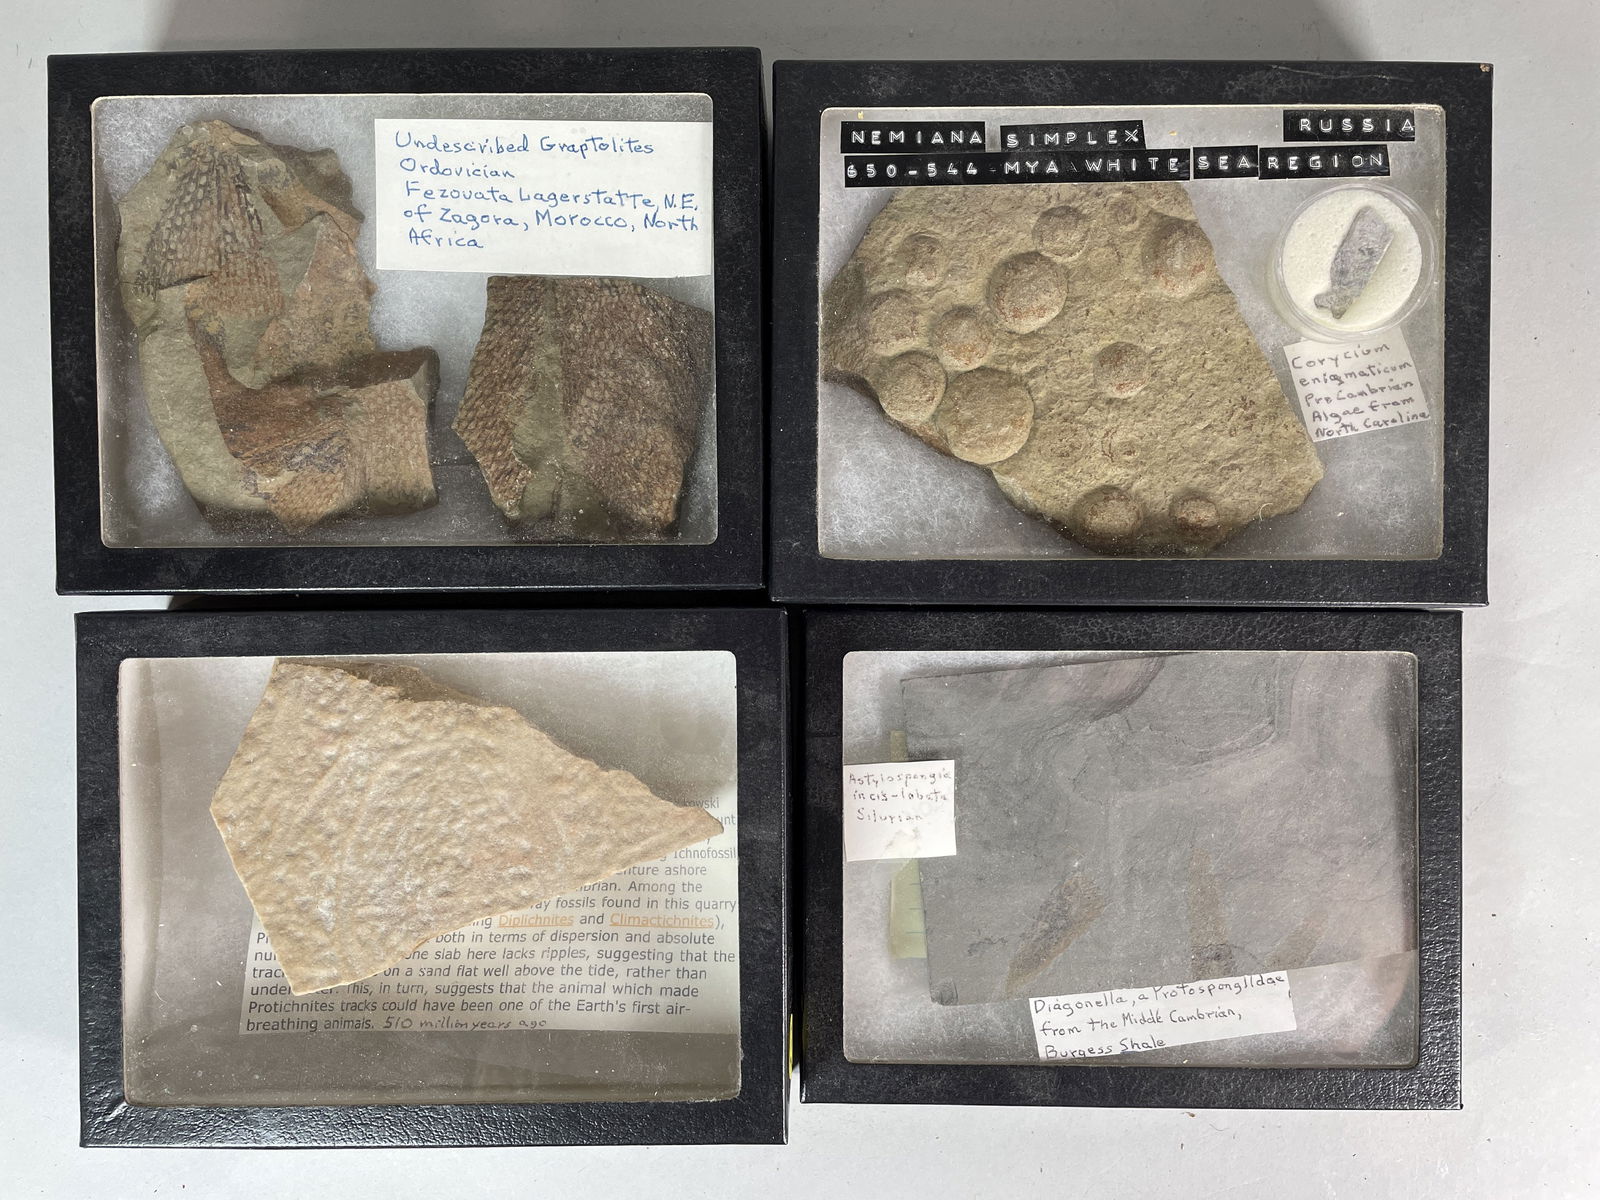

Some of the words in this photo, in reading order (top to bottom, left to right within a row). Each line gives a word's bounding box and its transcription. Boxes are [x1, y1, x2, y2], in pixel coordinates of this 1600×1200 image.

[1299, 118, 1414, 133] RUSSIA
[395, 131, 529, 153] Undescribed
[540, 135, 655, 159] Graptolites
[851, 130, 983, 146] NEMIANA
[1006, 129, 1139, 148] SIMPLEX
[400, 158, 515, 179] Ordovician
[1004, 160, 1059, 175] MYA
[1085, 157, 1180, 173] WHITE
[1197, 156, 1251, 170] SEA
[1267, 154, 1384, 171] REGION
[403, 204, 432, 223] of
[439, 207, 529, 231] Zagora,
[536, 210, 635, 232] Morocco,
[644, 213, 699, 231] North
[409, 228, 484, 249] Africa
[1312, 407, 1364, 424] Algae
[1368, 397, 1415, 412] from
[1315, 422, 1359, 438] North
[857, 807, 923, 824] Silurian
[665, 865, 707, 875] ashore
[628, 881, 676, 895] Among
[682, 881, 703, 892] the
[556, 897, 596, 909] fossils
[602, 897, 640, 909] found
[647, 897, 659, 909] in
[665, 897, 689, 910] this
[695, 899, 736, 912] quarry
[499, 914, 574, 928] Diplichnites
[580, 913, 604, 925] and
[471, 931, 483, 943] in
[489, 932, 526, 943] terms
[532, 930, 546, 943] of
[550, 930, 619, 946] dispersion
[626, 932, 650, 943] and
[656, 933, 715, 944] absolute
[434, 948, 461, 960] slab
[467, 948, 496, 960] here
[502, 947, 535, 960] lacks
[541, 946, 590, 962] ripples,
[597, 948, 673, 963] suggesting
[680, 949, 708, 962] that
[713, 950, 736, 963] the
[405, 968, 413, 977] a
[419, 965, 451, 977] sand
[457, 965, 479, 977] flat
[484, 964, 509, 977] well
[514, 964, 554, 977] above
[560, 964, 583, 977] the
[588, 964, 619, 979] tide,
[626, 966, 671, 979] rather
[676, 967, 707, 980] than
[379, 982, 391, 994] in
[396, 982, 428, 995] turn,
[435, 981, 494, 997] suggests
[499, 981, 526, 994] that
[532, 981, 554, 994] the
[559, 981, 606, 994] animal
[612, 982, 653, 996] which
[660, 984, 699, 998] made
[248, 1000, 335, 1014] Protichnites
[341, 999, 377, 1012] tracks
[382, 999, 417, 1012] could
[423, 999, 456, 1012] have
[461, 999, 493, 1012] been
[499, 1002, 524, 1012] one
[529, 998, 544, 1011] of
[548, 999, 571, 1012] the
[577, 1000, 626, 1013] Earth's
[632, 1001, 660, 1014] first
[666, 1003, 691, 1015] air-
[246, 1018, 318, 1033] breathing
[323, 1017, 375, 1030] animals.
[383, 1016, 413, 1029] 510
[420, 1016, 468, 1030] million
[470, 1020, 512, 1031] years
[519, 1019, 547, 1030] ago
[1040, 1021, 1081, 1036] from
[1087, 1018, 1118, 1031] the
[1169, 1006, 1242, 1023] Cambrian,
[1045, 1045, 1113, 1059] Burgess
[1120, 1035, 1166, 1051] Shale
